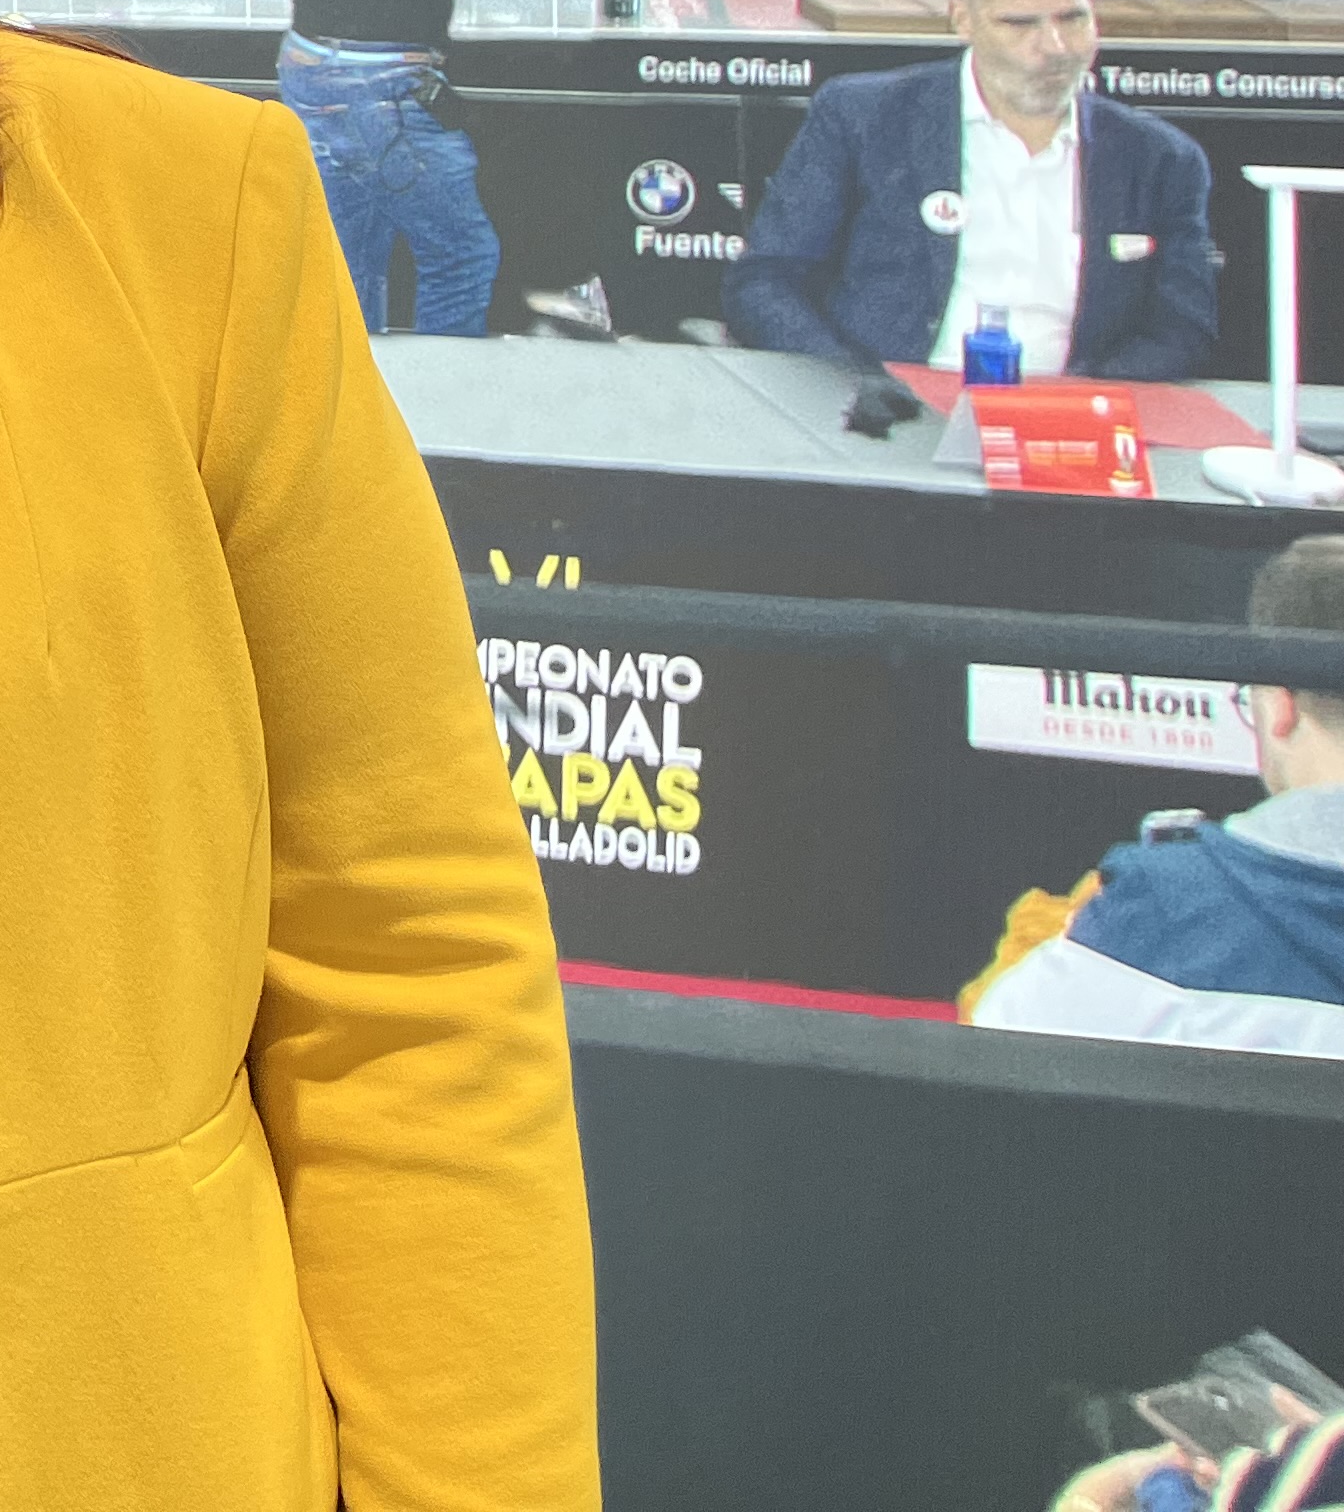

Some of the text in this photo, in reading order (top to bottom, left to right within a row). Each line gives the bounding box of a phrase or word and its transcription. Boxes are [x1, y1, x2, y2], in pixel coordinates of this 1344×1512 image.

[639, 55, 812, 87] Coche Oficial
[1101, 65, 1212, 98] Técnica
[635, 225, 749, 262] Fuente
[486, 683, 703, 770] NDIAL
[505, 744, 702, 833] APAS
[530, 813, 702, 876] LLADOLID
